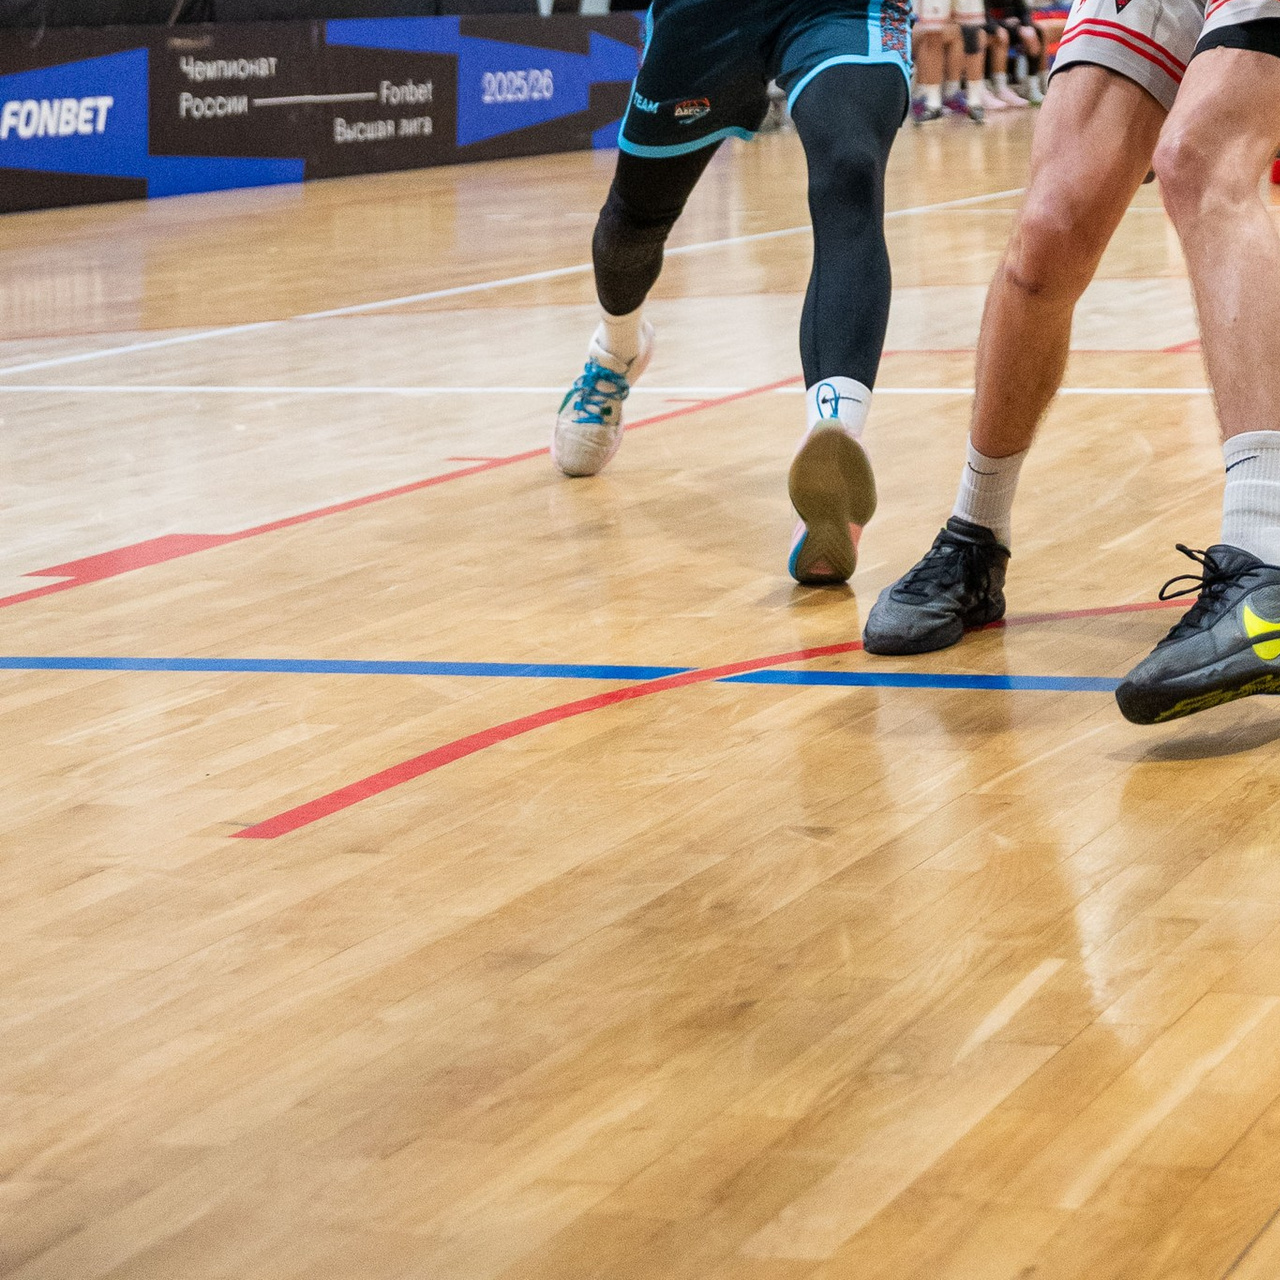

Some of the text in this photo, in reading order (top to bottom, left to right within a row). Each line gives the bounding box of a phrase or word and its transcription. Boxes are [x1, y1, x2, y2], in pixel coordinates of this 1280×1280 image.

[179, 55, 278, 82] Чемпионат
[179, 92, 249, 119] России
[379, 78, 433, 106] Fonbet
[0, 95, 114, 140] FONBET
